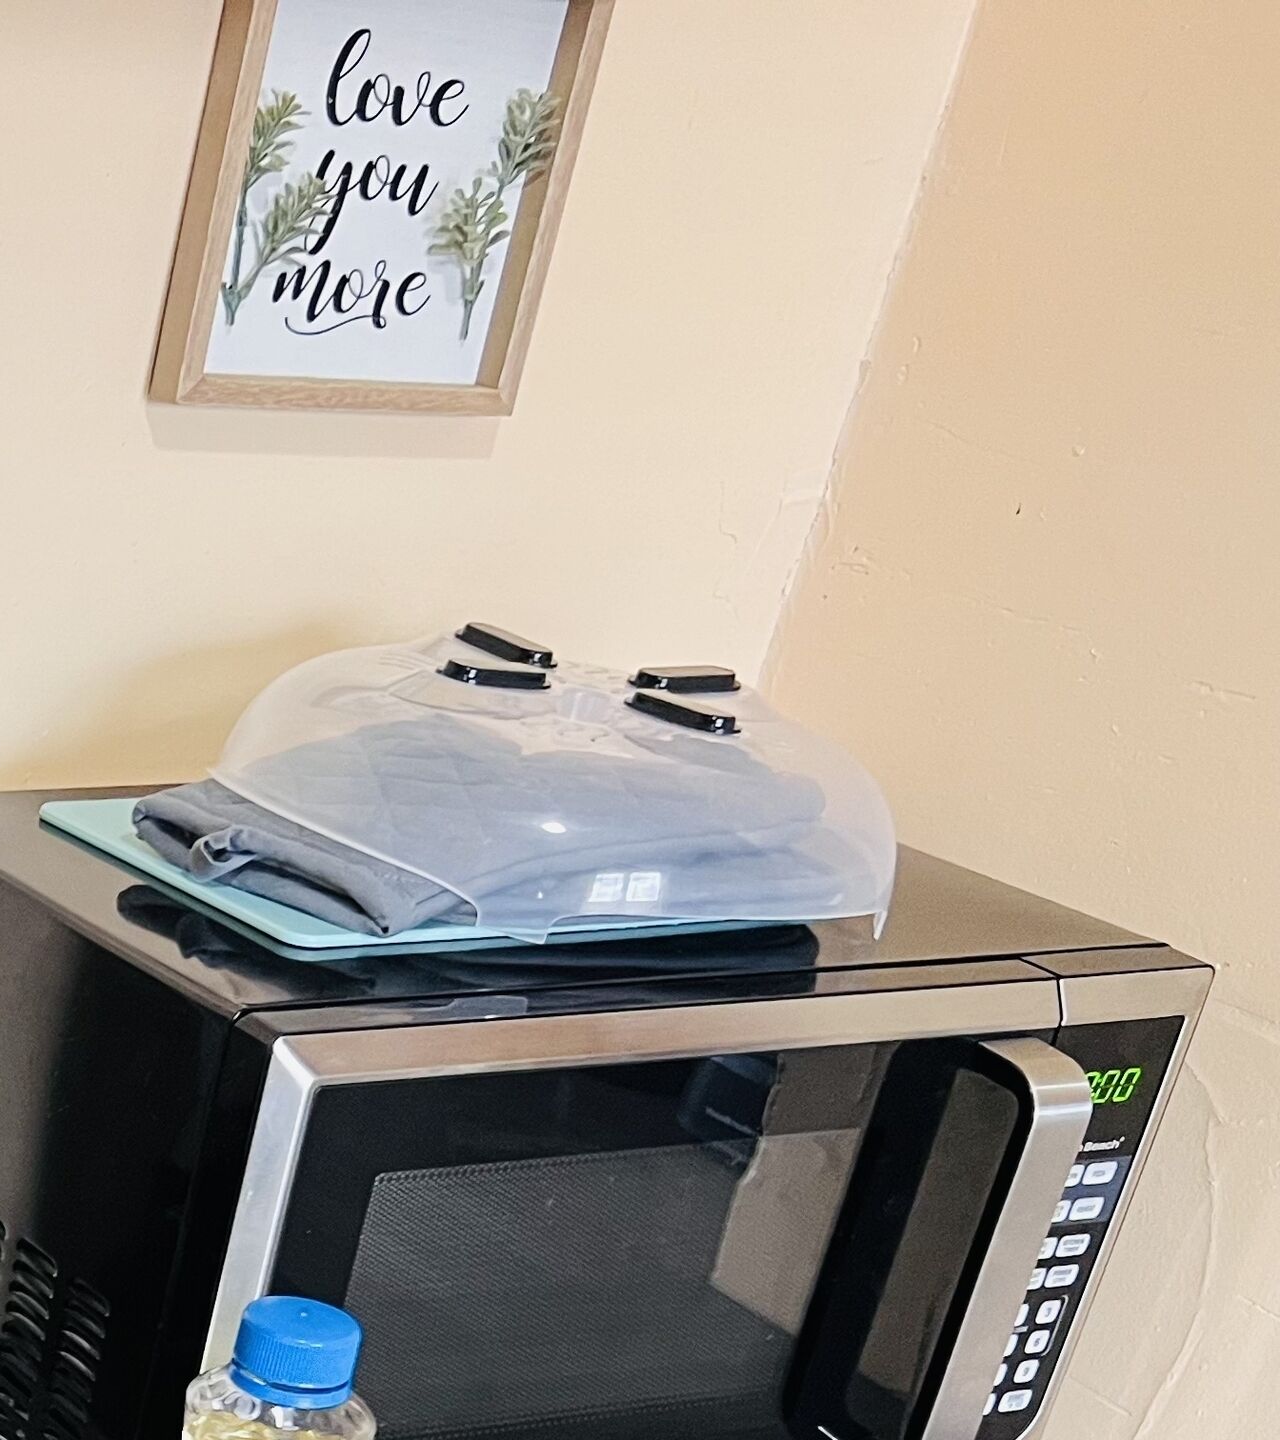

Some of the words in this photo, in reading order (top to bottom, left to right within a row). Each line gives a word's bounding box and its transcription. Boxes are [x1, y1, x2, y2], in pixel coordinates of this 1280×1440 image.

[325, 27, 470, 128] love
[304, 148, 440, 256] you
[271, 258, 432, 335] more
